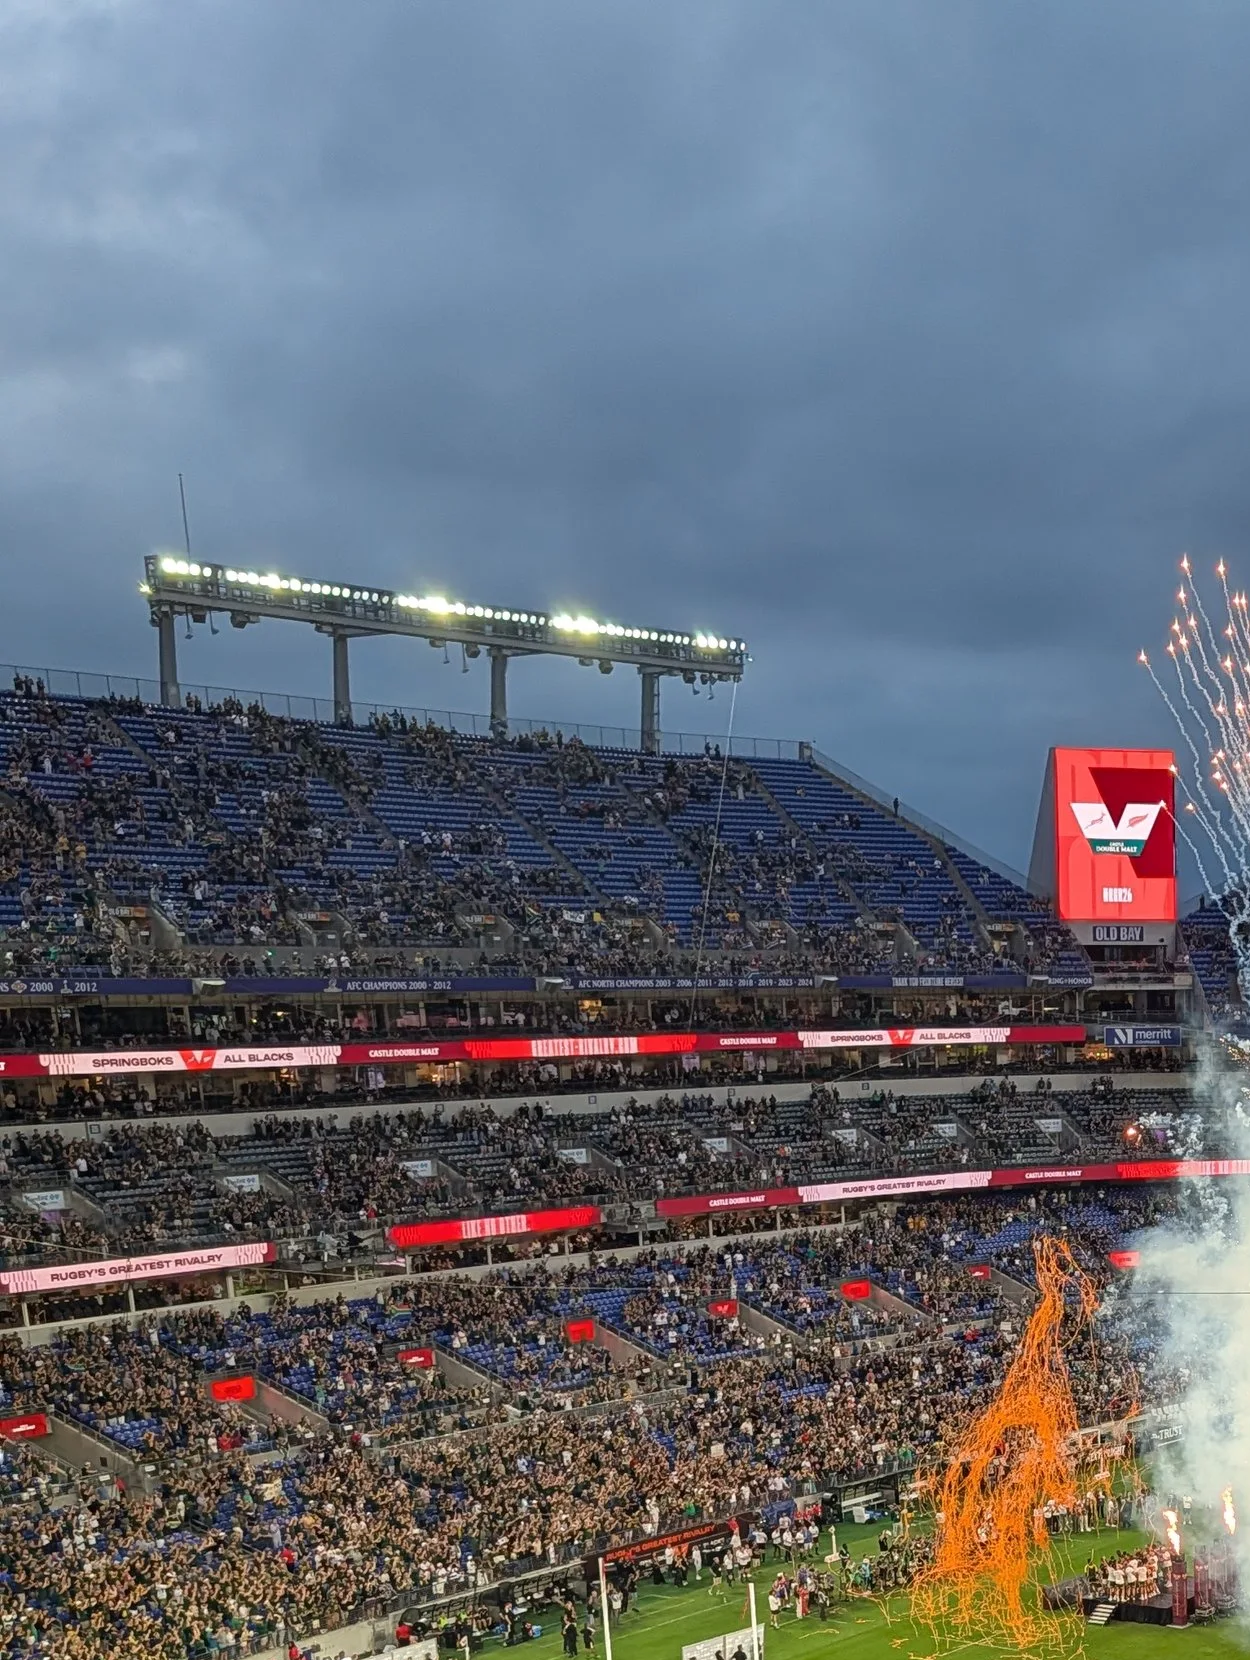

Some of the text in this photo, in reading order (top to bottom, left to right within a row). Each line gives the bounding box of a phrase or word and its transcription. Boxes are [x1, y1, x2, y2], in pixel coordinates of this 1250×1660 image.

[1095, 926, 1142, 942] OLD BAY
[30, 982, 54, 992] 2000
[75, 982, 98, 992] 2012
[346, 980, 451, 991] AFC CHAMPIONS 2000 2012
[578, 980, 590, 989] AFC
[591, 979, 615, 989] NORTH
[615, 979, 654, 988] CHAMPIONS
[655, 979, 671, 988] 2003
[676, 979, 692, 988] 2006
[697, 979, 713, 987] 2011
[718, 979, 734, 987] 2012
[758, 978, 774, 987] 2019
[778, 978, 793, 987] 2023
[797, 978, 813, 987] 2024
[1068, 977, 1093, 985] HONOR
[830, 1031, 972, 1043] SPRINGBOKS ALL BLACKS
[1134, 1027, 1172, 1040] merritt
[720, 1036, 778, 1046] CASTLE DOUBLE MALT
[369, 1047, 440, 1058] CASTLE DOUBLE MALT
[92, 1052, 294, 1068] SPRINGBOKS ALL BLACKS
[1025, 1171, 1046, 1179] CASTLE
[1067, 1169, 1082, 1177] MALT
[842, 1178, 946, 1194] RUGBY'S GREATEST RIVALRY
[709, 1194, 765, 1207] CASTLE DOUBLE MALT
[461, 1218, 484, 1240] LIKE
[50, 1253, 223, 1282] RUGBY'S GREATEST RIVALRY
[1159, 1426, 1183, 1441] TRUST
[641, 1534, 683, 1551] GREATEST
[683, 1524, 716, 1539] RIVALRY
